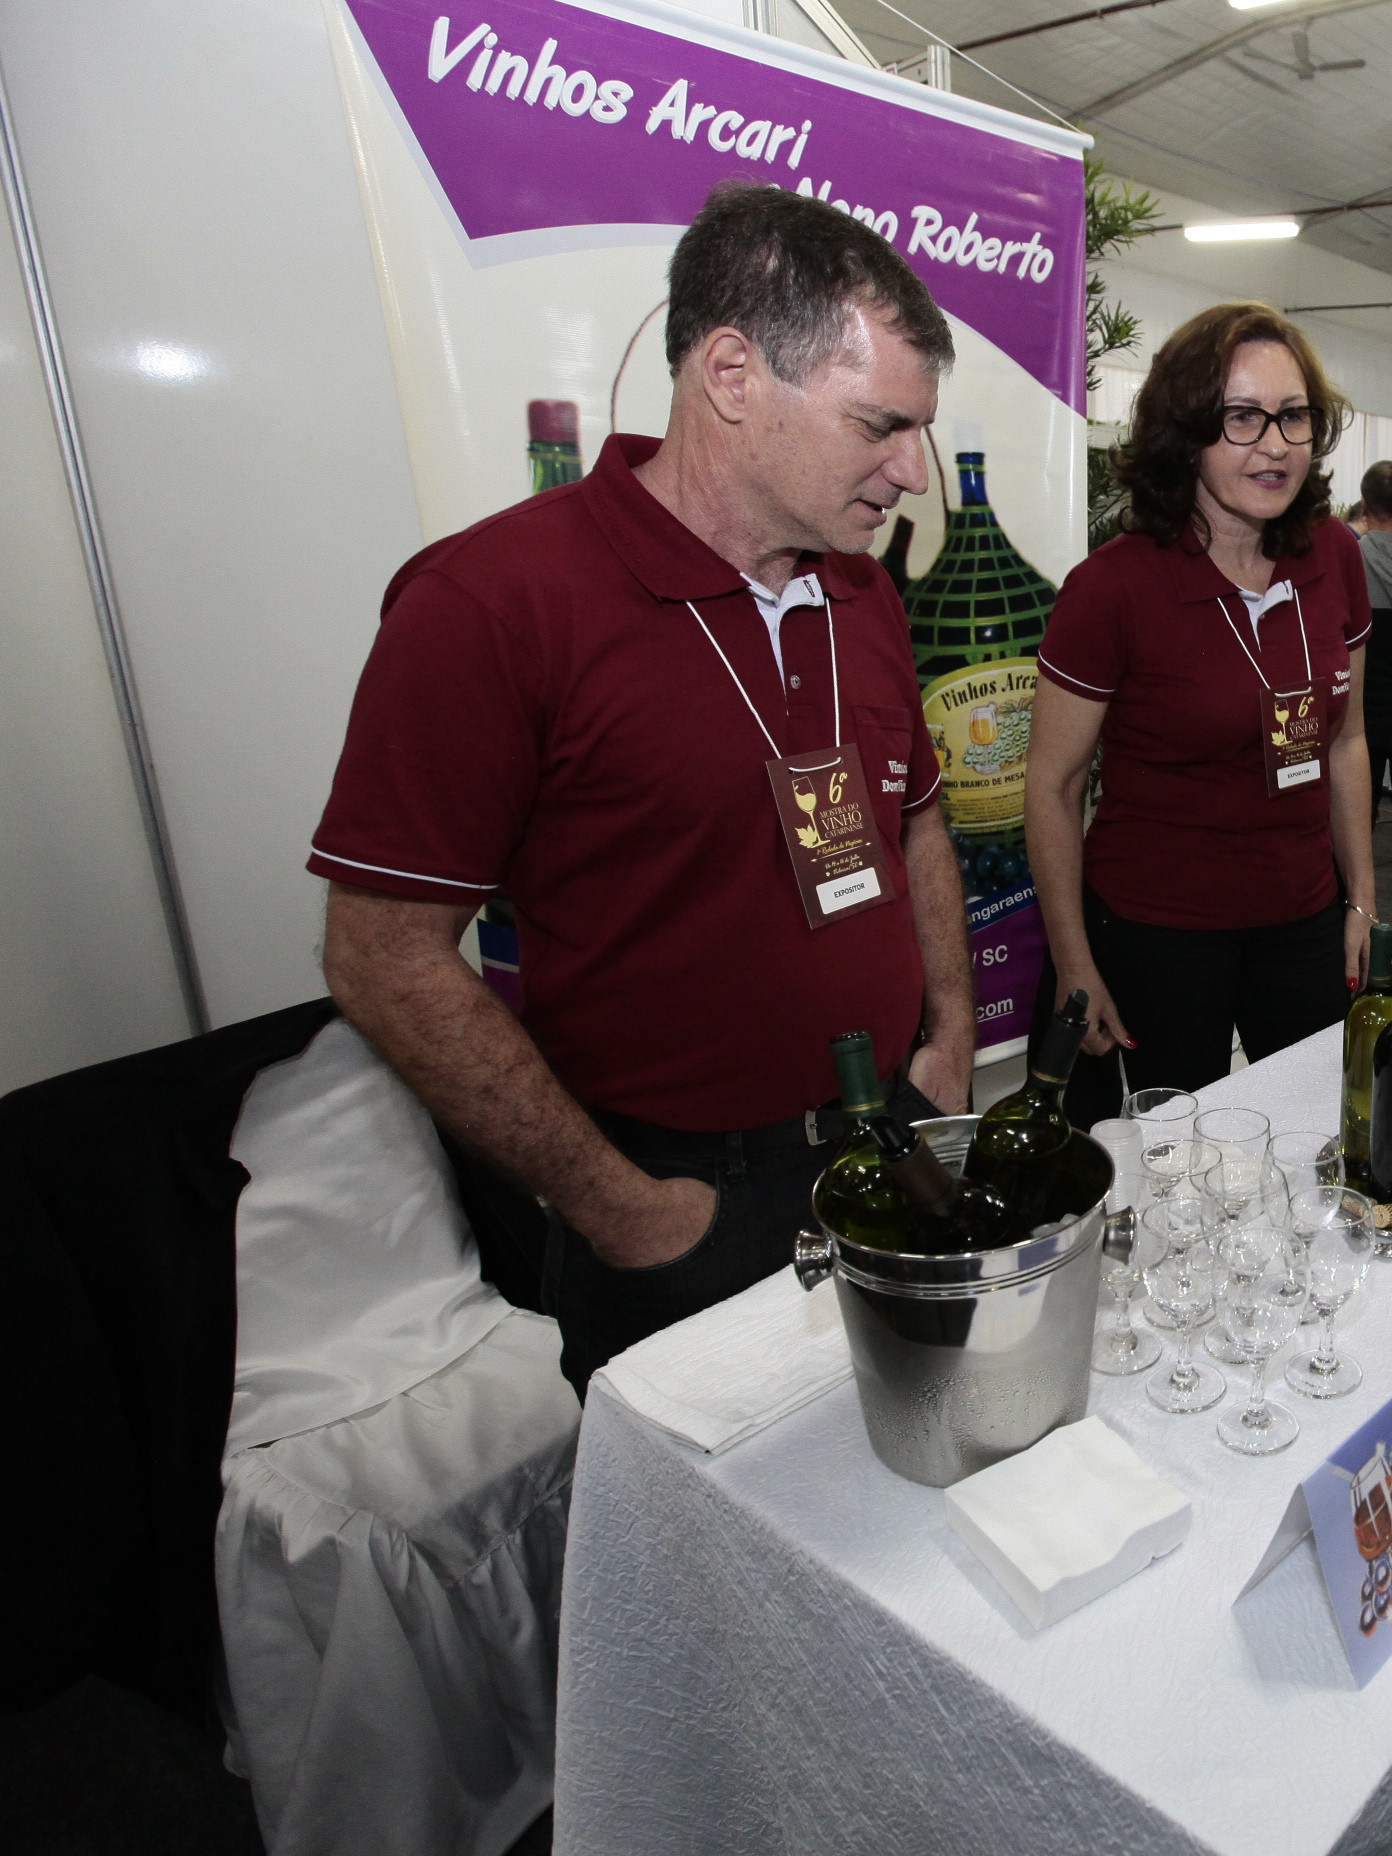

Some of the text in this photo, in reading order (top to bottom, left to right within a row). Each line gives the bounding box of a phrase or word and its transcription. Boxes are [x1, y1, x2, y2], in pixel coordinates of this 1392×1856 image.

[427, 15, 812, 170] Vinhos Arcari
[907, 205, 1054, 284] Roberto
[940, 680, 998, 712] Vinhos
[1289, 721, 1319, 735] VINHO
[960, 779, 990, 788] BRANCO
[992, 777, 1002, 786] DE
[1005, 771, 1025, 783] MESA
[1287, 768, 1310, 779] EXPOSITOR
[819, 803, 859, 819] MOSTRA DO
[821, 810, 862, 831] VINHO
[824, 822, 864, 839] CATARINENSE
[833, 882, 866, 899] EXPOSITOR
[982, 944, 1008, 966] SC
